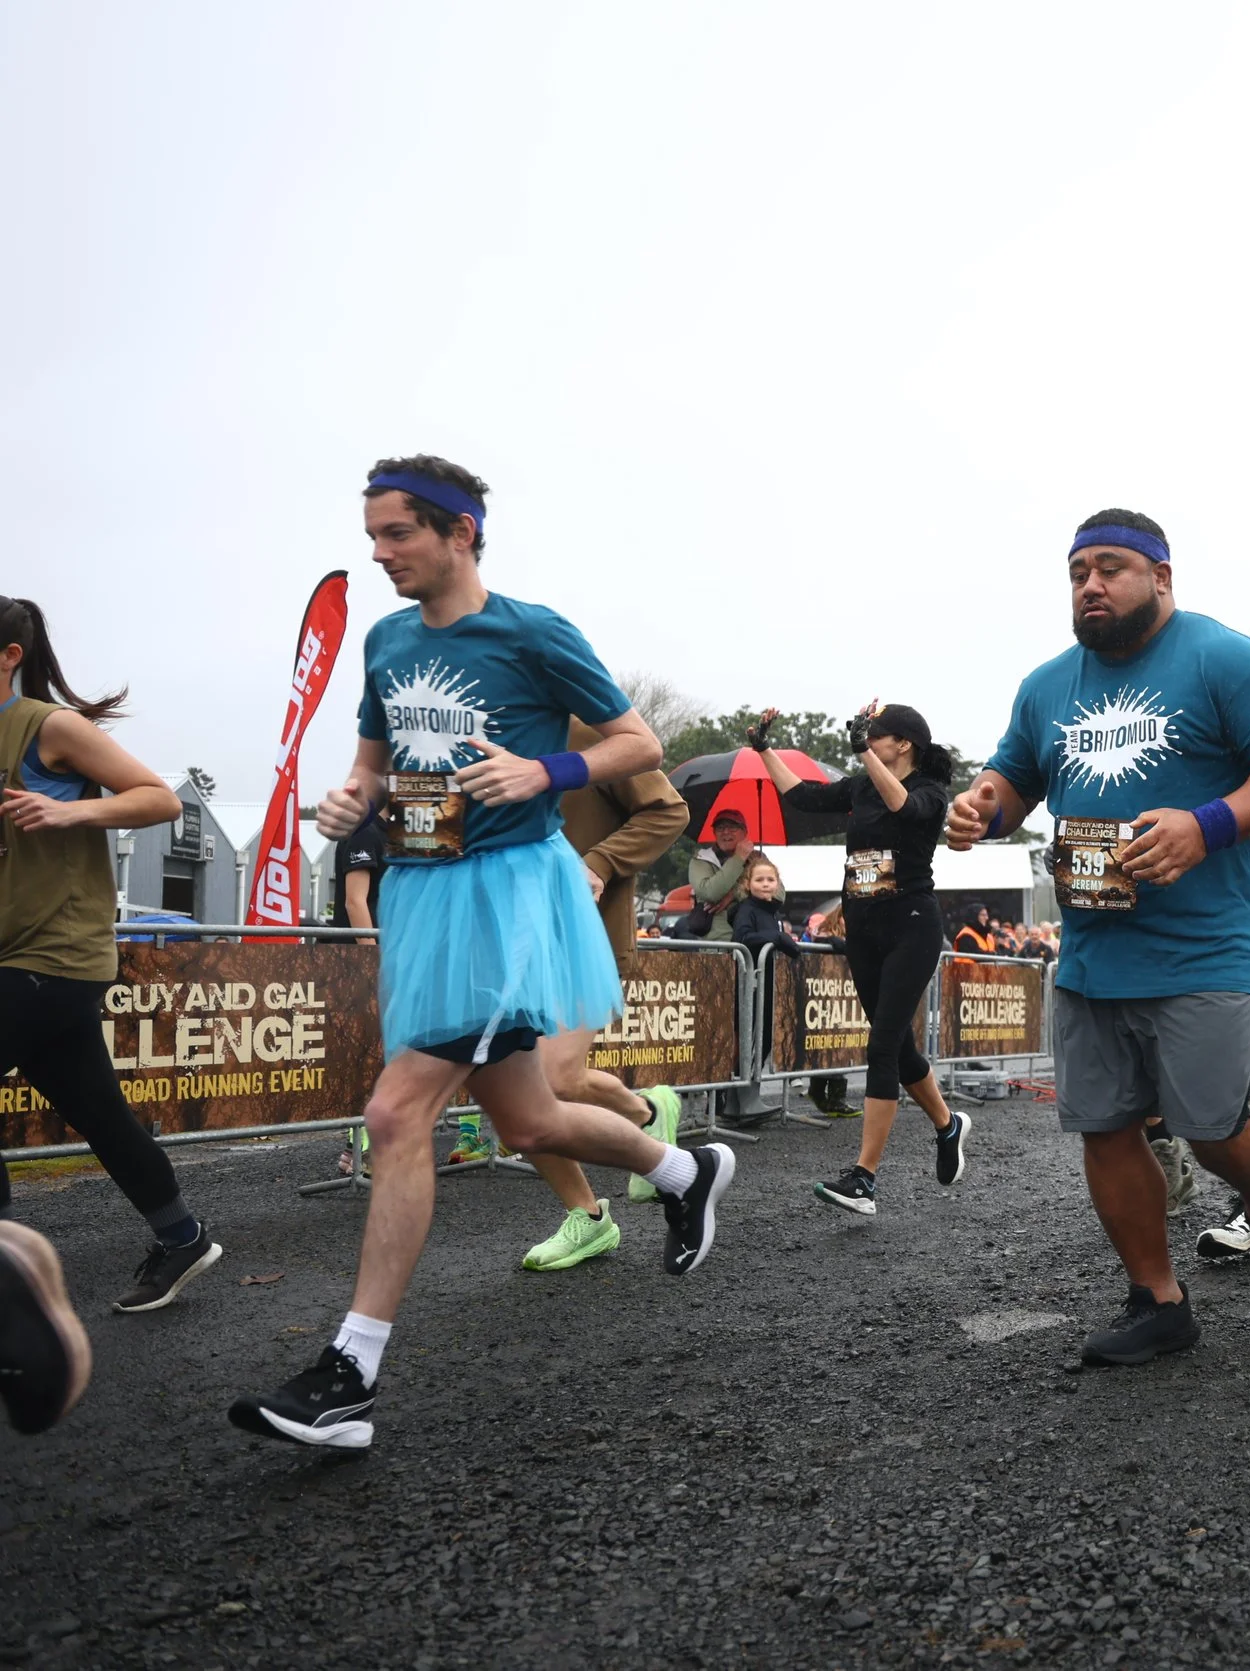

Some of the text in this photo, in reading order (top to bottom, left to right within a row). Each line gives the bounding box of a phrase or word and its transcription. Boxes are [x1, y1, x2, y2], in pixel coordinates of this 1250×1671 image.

[392, 705, 474, 736] BRITOMUD
[1070, 730, 1079, 754] TEAM
[1079, 718, 1157, 753] BRITOMUD
[404, 806, 436, 834] 505
[1066, 827, 1117, 839] CHALLENGE
[855, 869, 877, 884] 506
[1071, 849, 1106, 877] 539
[1071, 879, 1104, 891] JEREMY
[104, 982, 325, 1014] GUY AND GAL
[627, 980, 695, 1001] AND GAL
[805, 977, 858, 997] TOUGH GU
[960, 982, 1026, 999] TOUGH GUY AND GAL
[593, 1004, 695, 1043] LENGE
[805, 999, 871, 1030] CHALL
[960, 999, 1026, 1025] CHALLENGE
[102, 1014, 326, 1070] LLENGE
[594, 1050, 620, 1069] ROAD
[622, 1047, 664, 1067] RUNNING
[666, 1045, 695, 1063] EVENT
[119, 1067, 325, 1104] ROAD RUNNING EVENT
